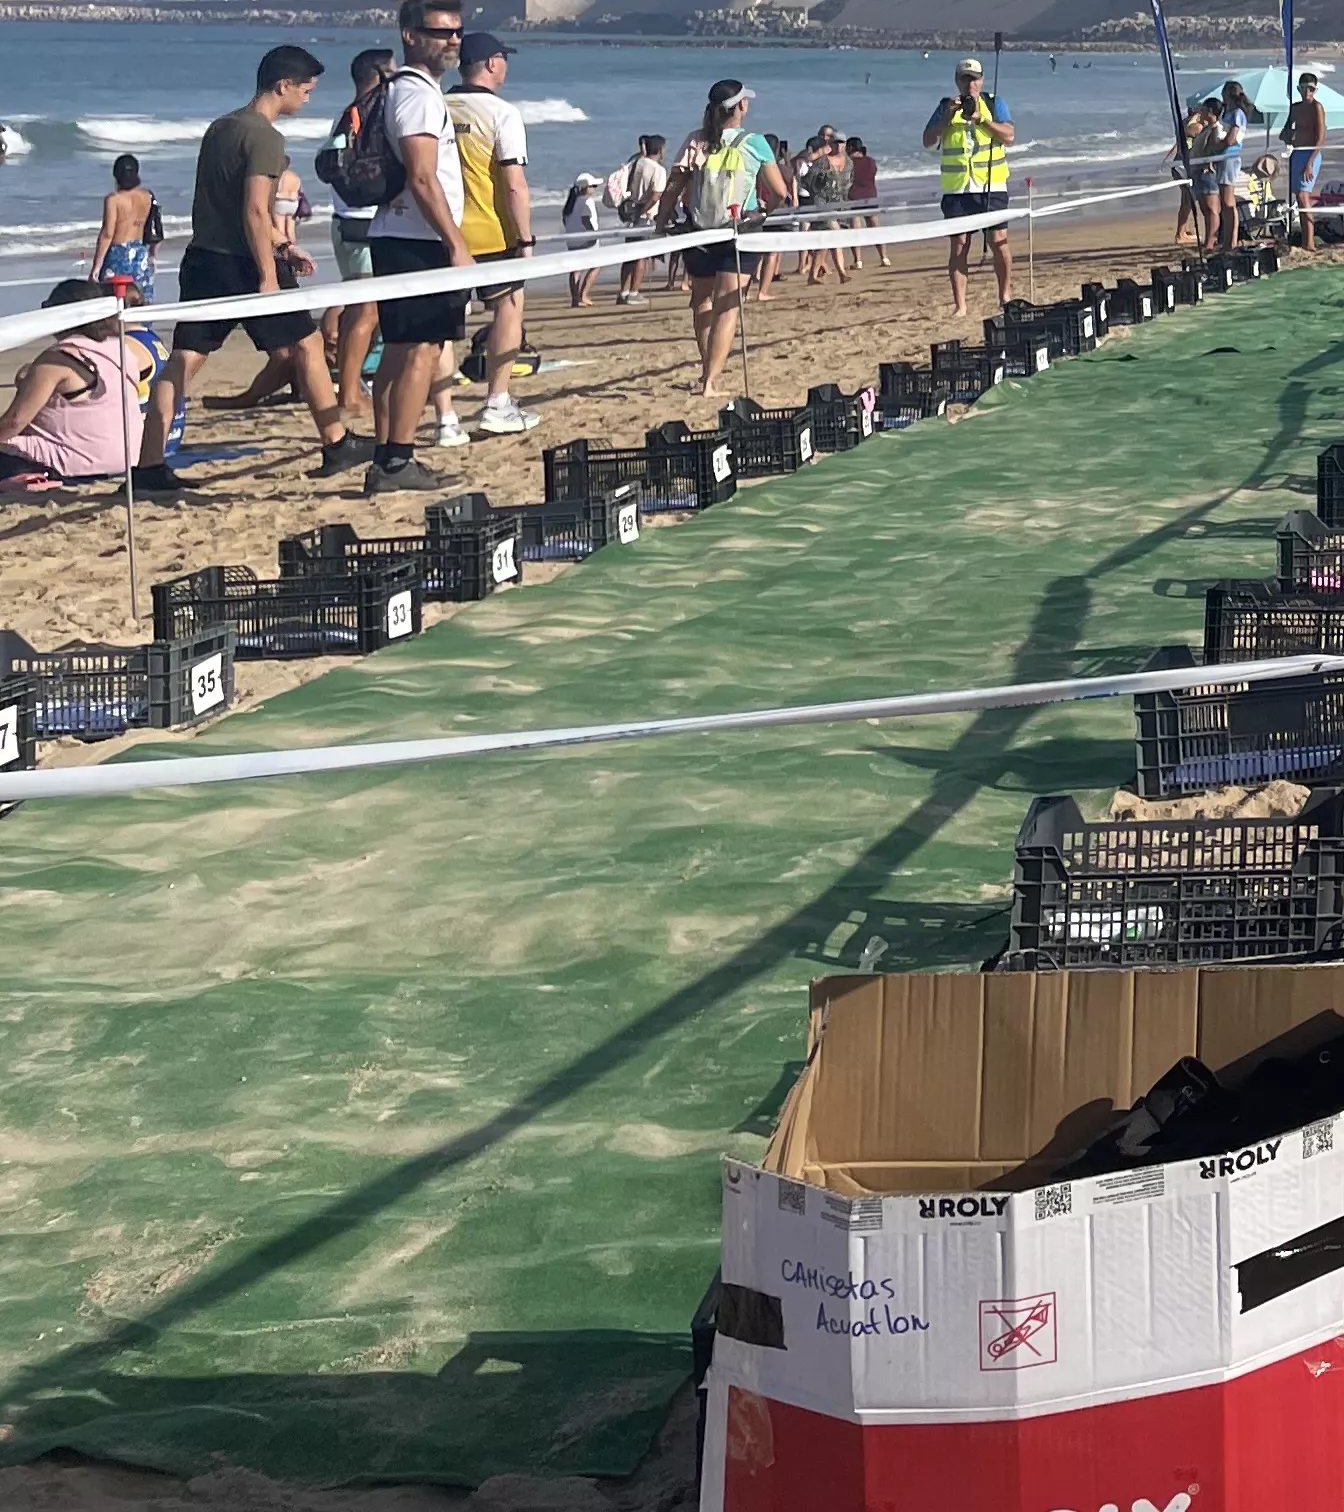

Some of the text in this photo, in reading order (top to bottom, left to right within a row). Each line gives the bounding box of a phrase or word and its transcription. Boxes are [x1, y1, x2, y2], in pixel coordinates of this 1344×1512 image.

[621, 514, 634, 534] 29
[496, 547, 509, 572] 31
[392, 603, 406, 626] 33
[197, 669, 216, 699] 35
[1219, 1138, 1283, 1178] ROLY
[938, 1195, 1011, 1218] ROLY
